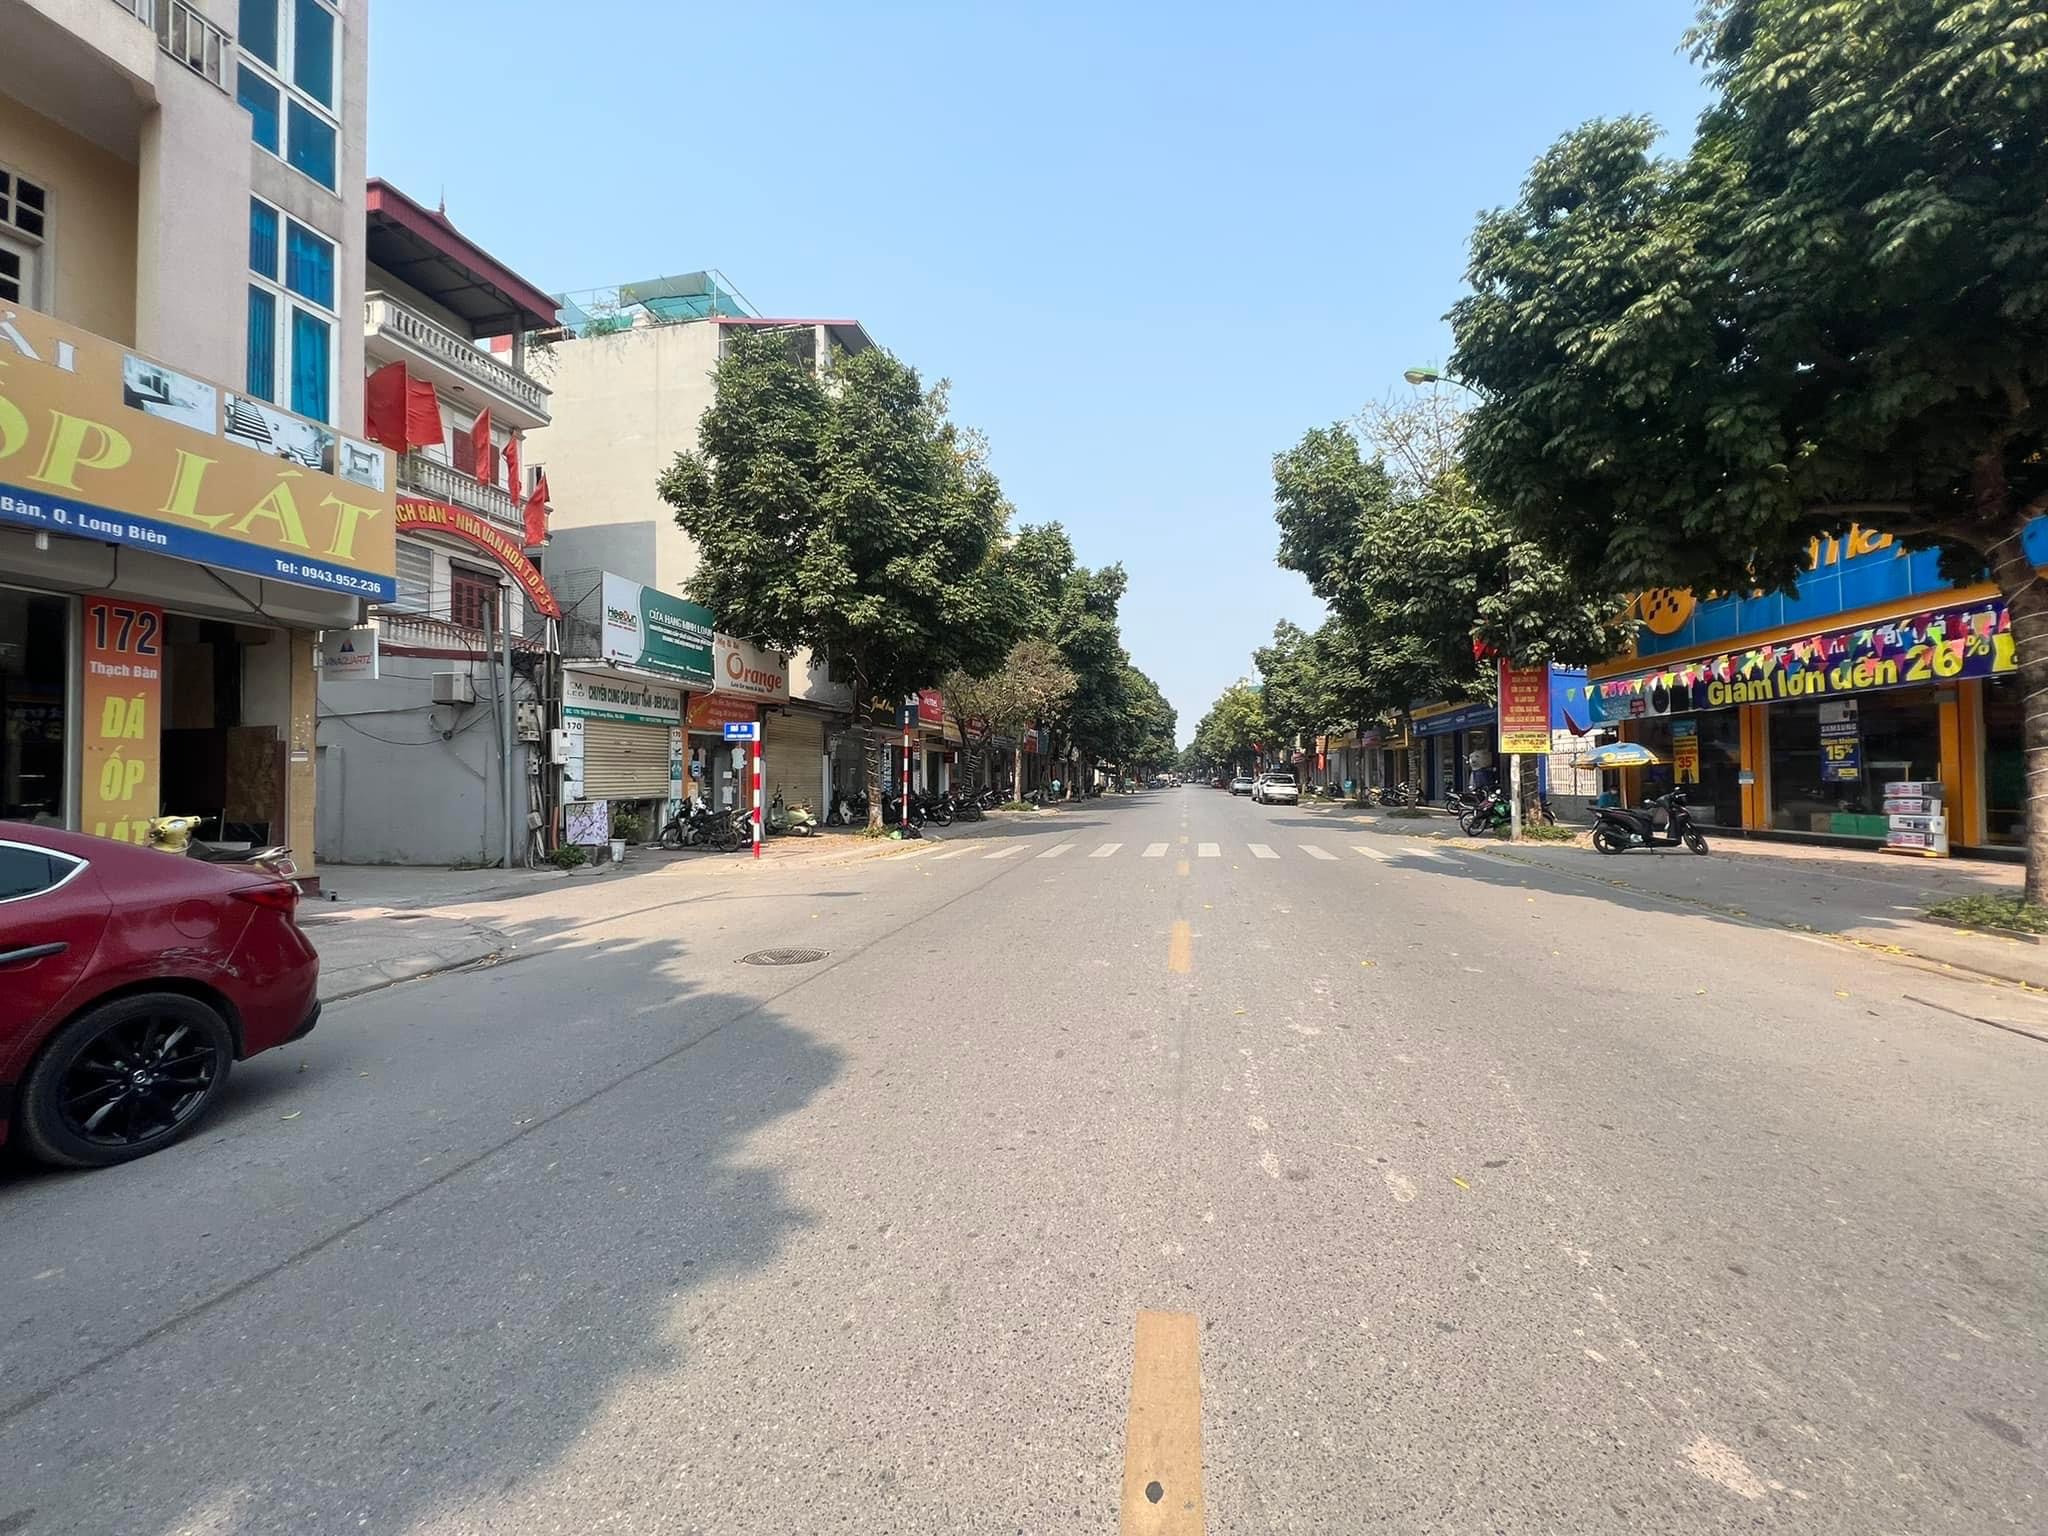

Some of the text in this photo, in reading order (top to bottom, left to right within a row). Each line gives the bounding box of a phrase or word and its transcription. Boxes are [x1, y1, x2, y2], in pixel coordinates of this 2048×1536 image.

[0, 496, 168, 545] Bàn, Q. Long Biên
[275, 559, 381, 593] Tel: 0943.952.236
[90, 603, 160, 656] 172
[90, 661, 158, 679] Thạch Bàn
[726, 652, 783, 693] Orange
[1708, 674, 1774, 706] Giảm
[101, 692, 146, 739] ĐÁ
[567, 721, 582, 730] 170
[101, 745, 146, 801] ỐP
